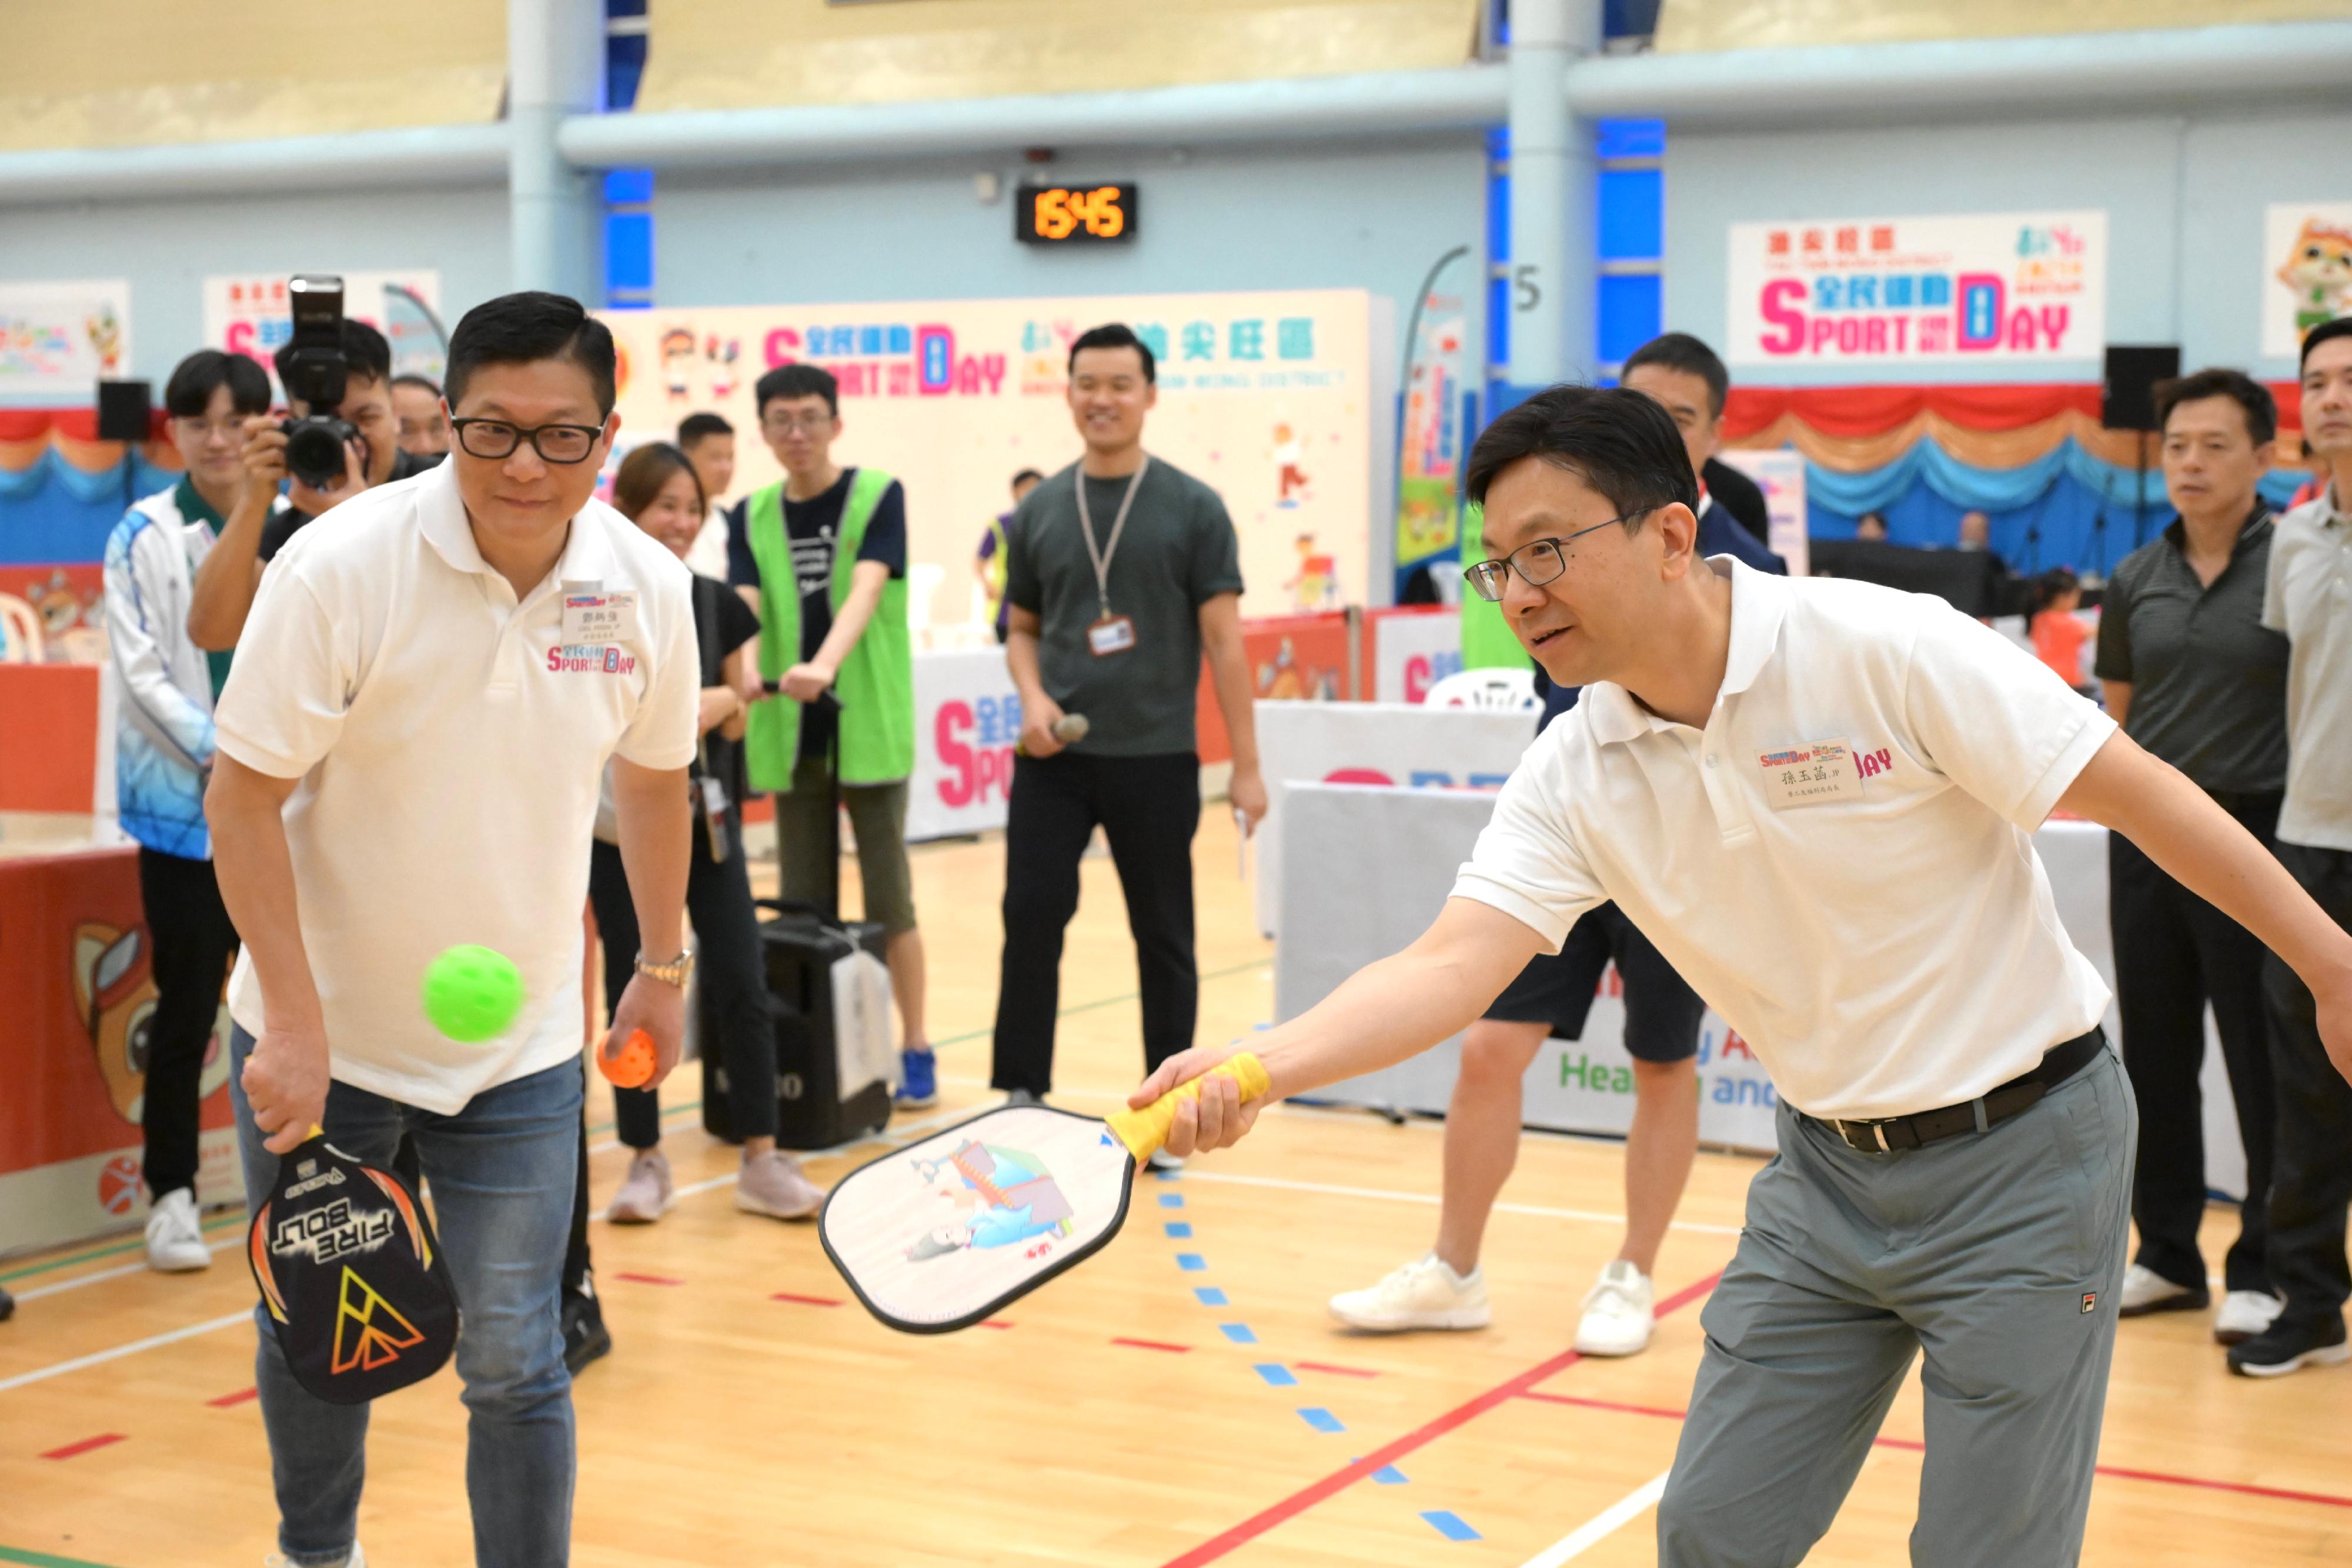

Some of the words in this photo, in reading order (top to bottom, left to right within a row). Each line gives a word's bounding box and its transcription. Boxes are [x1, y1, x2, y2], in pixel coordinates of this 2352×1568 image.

[1516, 266, 1541, 311] 5
[1759, 279, 1906, 354] SPORT
[1957, 273, 2070, 352] DAY
[917, 323, 1007, 396] DAY
[547, 647, 593, 672] SPORT
[603, 648, 635, 674] DAY
[273, 1201, 350, 1251] BOLT
[316, 1212, 392, 1262] FIRE
